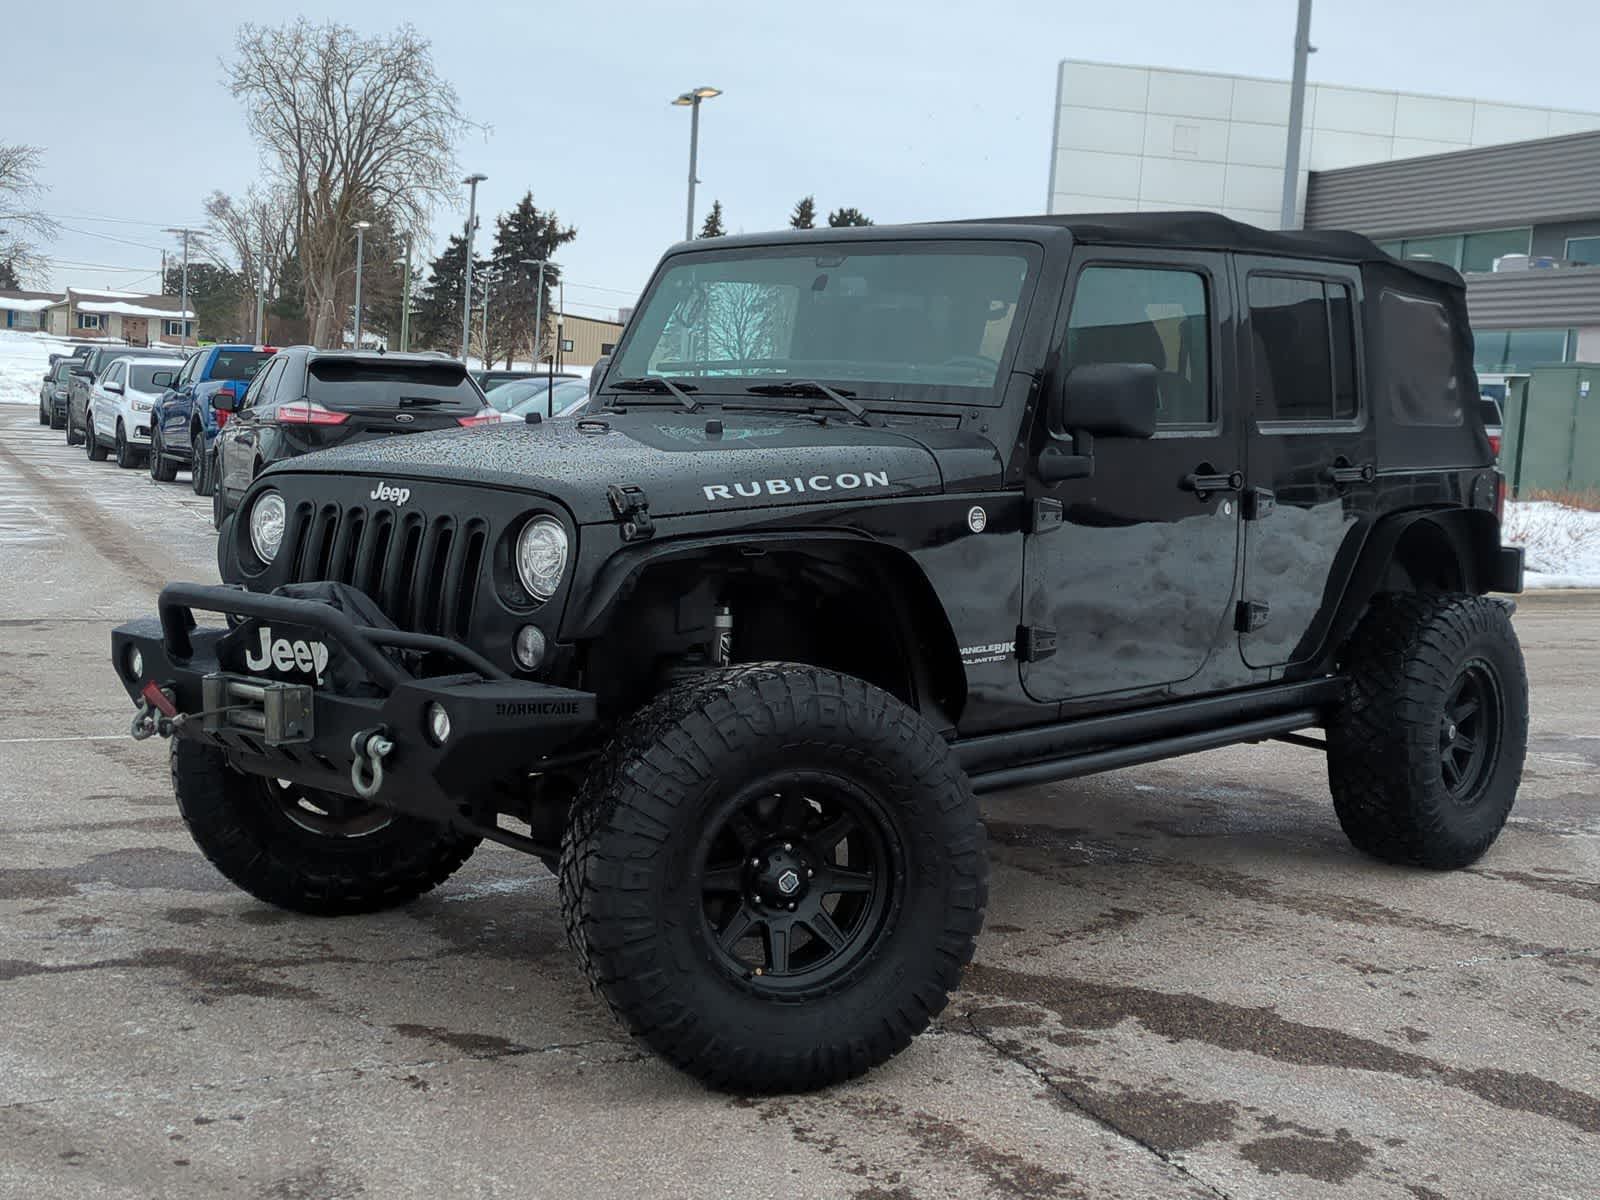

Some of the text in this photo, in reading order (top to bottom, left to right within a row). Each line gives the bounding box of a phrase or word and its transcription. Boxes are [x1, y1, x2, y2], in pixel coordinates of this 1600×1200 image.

[370, 481, 410, 506] Jeep
[703, 471, 889, 501] RUBICON
[245, 627, 329, 686] Jeep
[960, 643, 1001, 655] ANGLER
